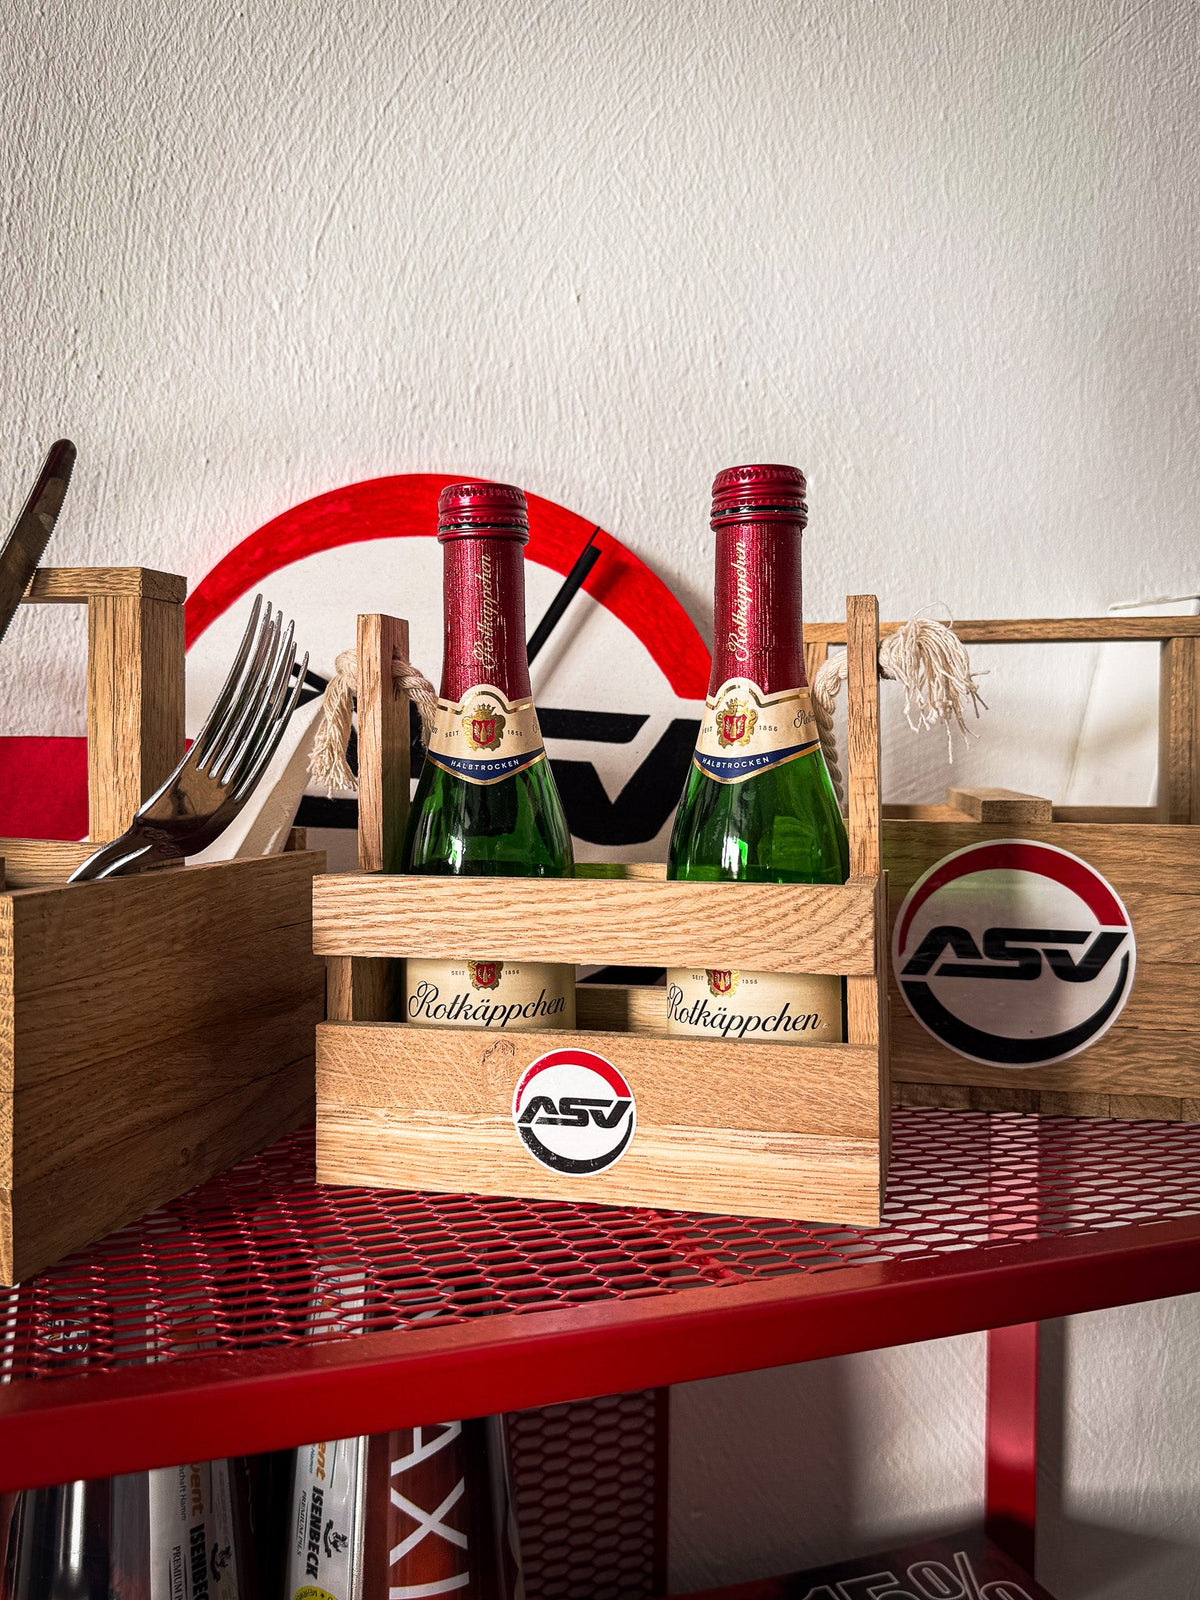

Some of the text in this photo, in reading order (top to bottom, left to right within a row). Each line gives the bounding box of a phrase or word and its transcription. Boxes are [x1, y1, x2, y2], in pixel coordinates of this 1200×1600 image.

[471, 552, 500, 670] Rotkäppchen
[727, 541, 750, 663] Rotkäppchen
[444, 730, 460, 738] SEIT
[450, 759, 520, 772] HALBTROCKEN
[702, 756, 770, 770] HALBTROCKEN
[900, 925, 1129, 983] ASV
[408, 980, 567, 1028] Rotkäppchen
[667, 982, 822, 1039] Rotkäppchen
[516, 1095, 633, 1129] ASV
[178, 1465, 187, 1493] schaft
[305, 1485, 324, 1580] ISENBECK
[389, 1420, 470, 1600] AXI
[172, 1545, 183, 1592] PREMIUM
[189, 1523, 210, 1600] ISENBEC
